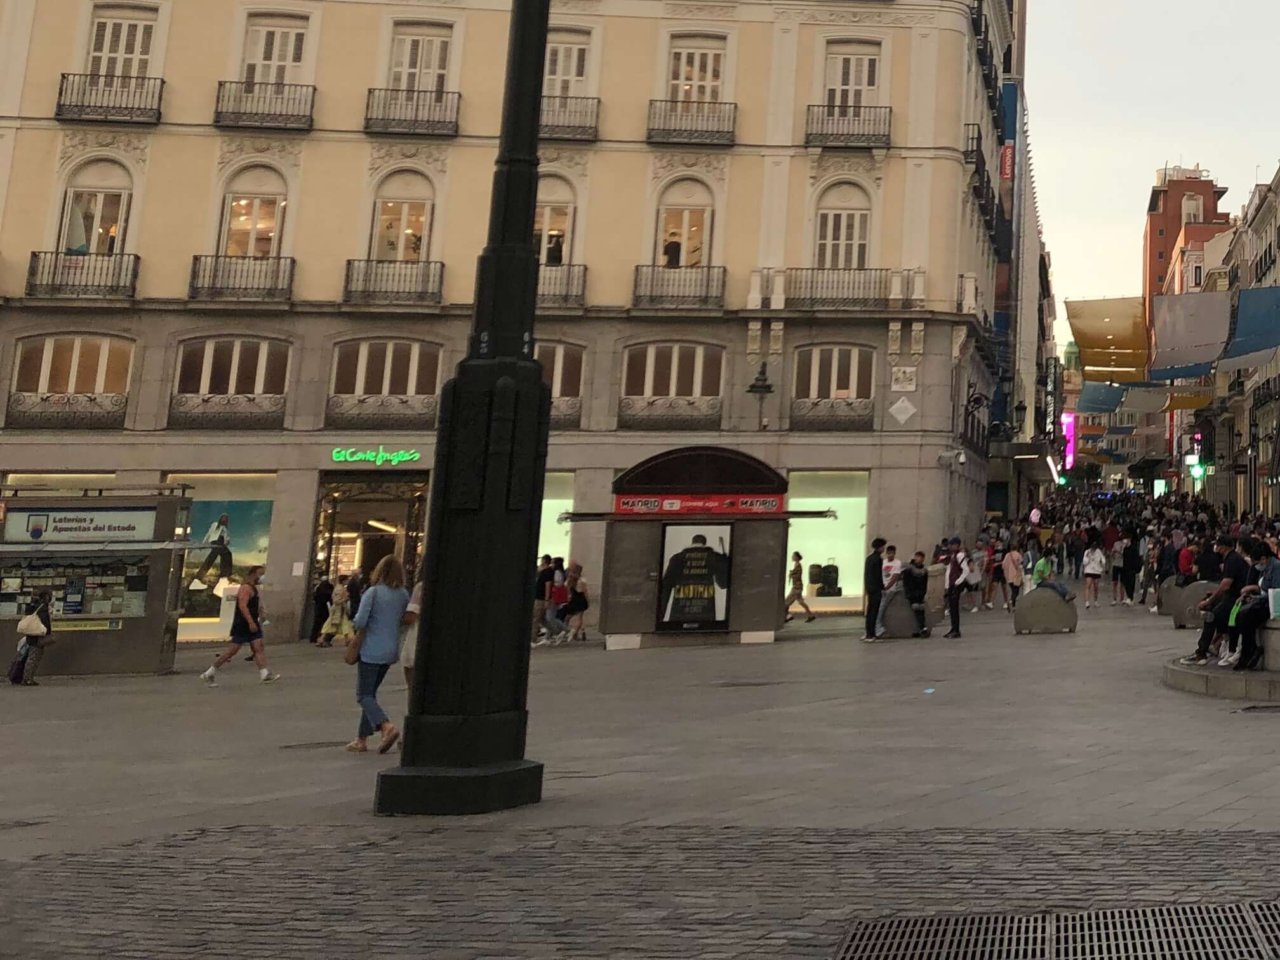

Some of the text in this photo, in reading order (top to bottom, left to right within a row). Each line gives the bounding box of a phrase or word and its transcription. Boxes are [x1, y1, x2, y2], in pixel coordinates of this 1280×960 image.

[1003, 148, 1012, 178] Lenovo
[620, 498, 661, 509] MADRID
[739, 498, 779, 509] MADRID
[52, 524, 136, 534] Apuestas del Estado
